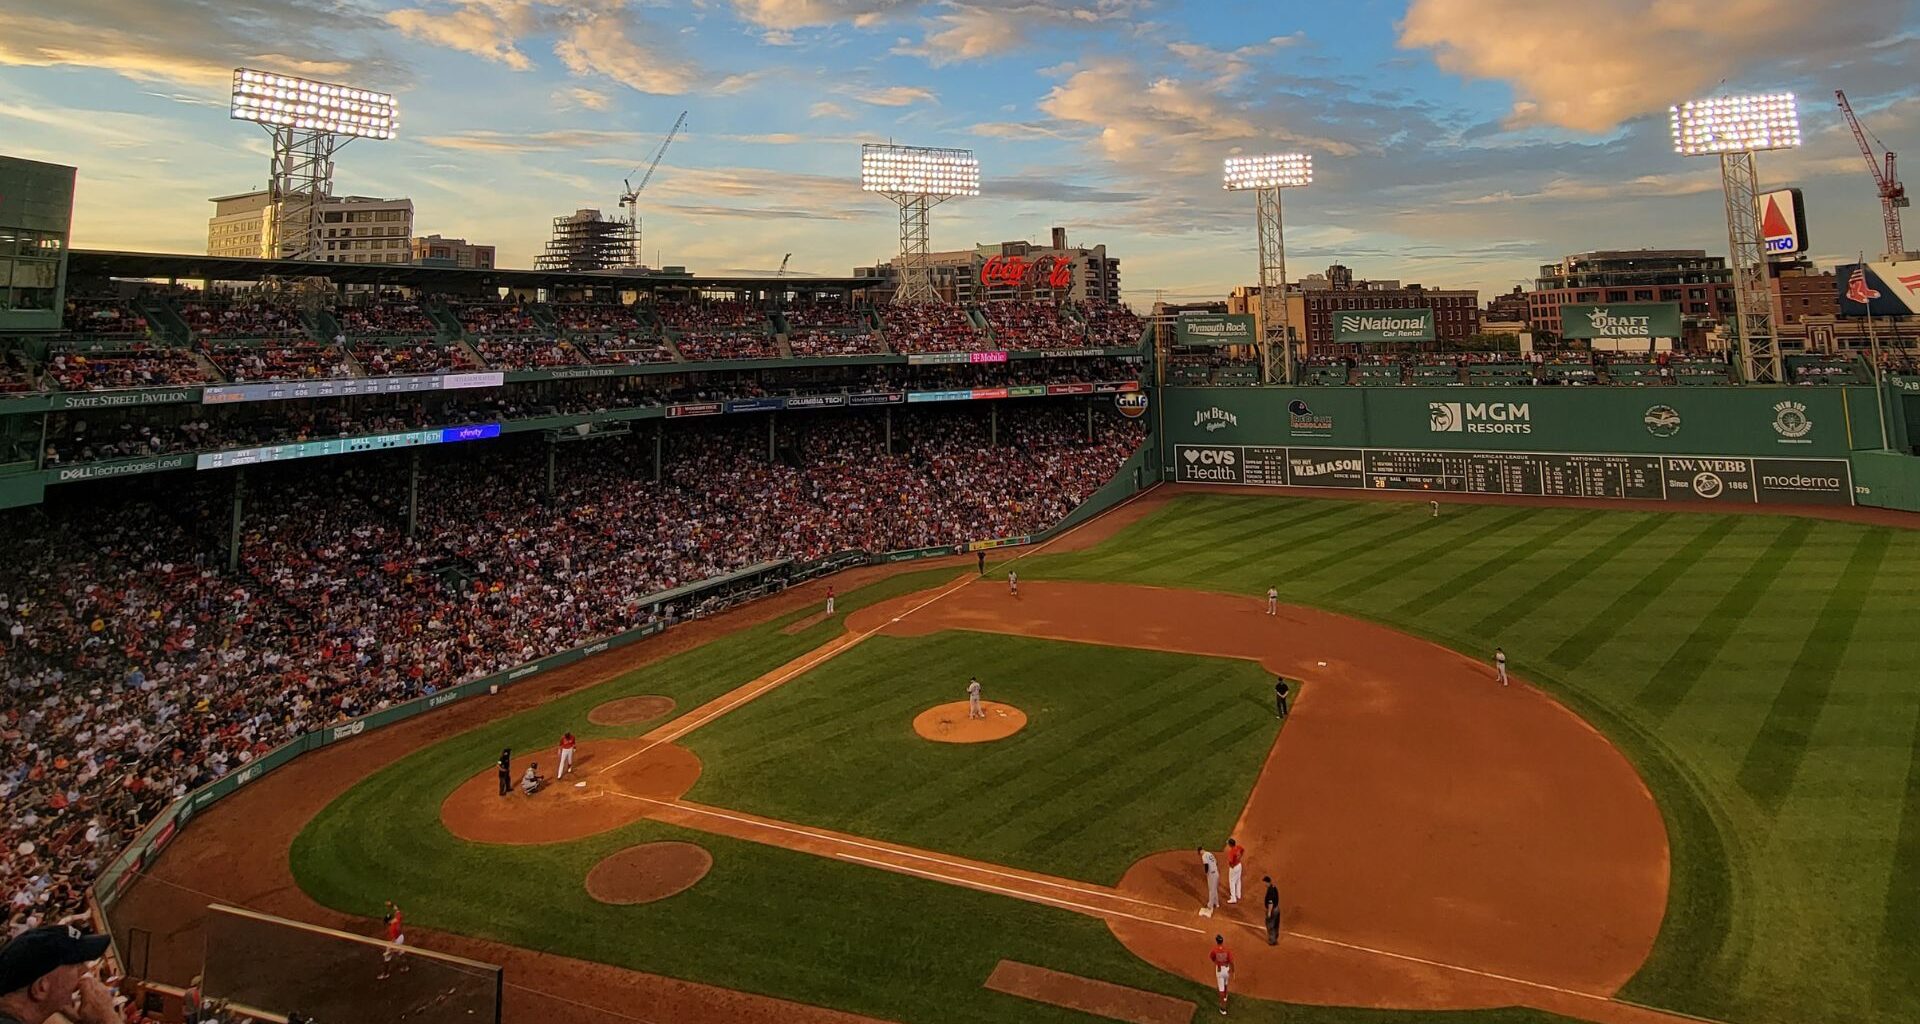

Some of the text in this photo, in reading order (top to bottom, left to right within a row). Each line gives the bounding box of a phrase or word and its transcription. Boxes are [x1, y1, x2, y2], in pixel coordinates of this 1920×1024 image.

[1187, 322, 1247, 334] Plymouth Rock
[1359, 315, 1425, 330] National
[1591, 315, 1650, 329] DRAFT
[1600, 325, 1649, 335] KINGS
[1083, 349, 1104, 357] MATTER
[589, 368, 614, 377] PAVILION
[65, 391, 188, 408] STATE STREET PAVILION
[788, 396, 842, 406] COLUMBIA TECH
[1118, 395, 1146, 407] Gulf
[1194, 410, 1211, 427] JIM
[1211, 407, 1238, 427] BEAM
[1465, 402, 1530, 421] MGM
[426, 428, 483, 441] 6TH xfinity
[1467, 423, 1532, 434] RESORTS
[1200, 449, 1236, 465] CVS
[60, 457, 183, 480] DELL Technologies Level
[1186, 464, 1237, 480] Health
[1698, 460, 1746, 473] WEBB
[1669, 479, 1689, 488] Since
[1762, 474, 1840, 488] moderna
